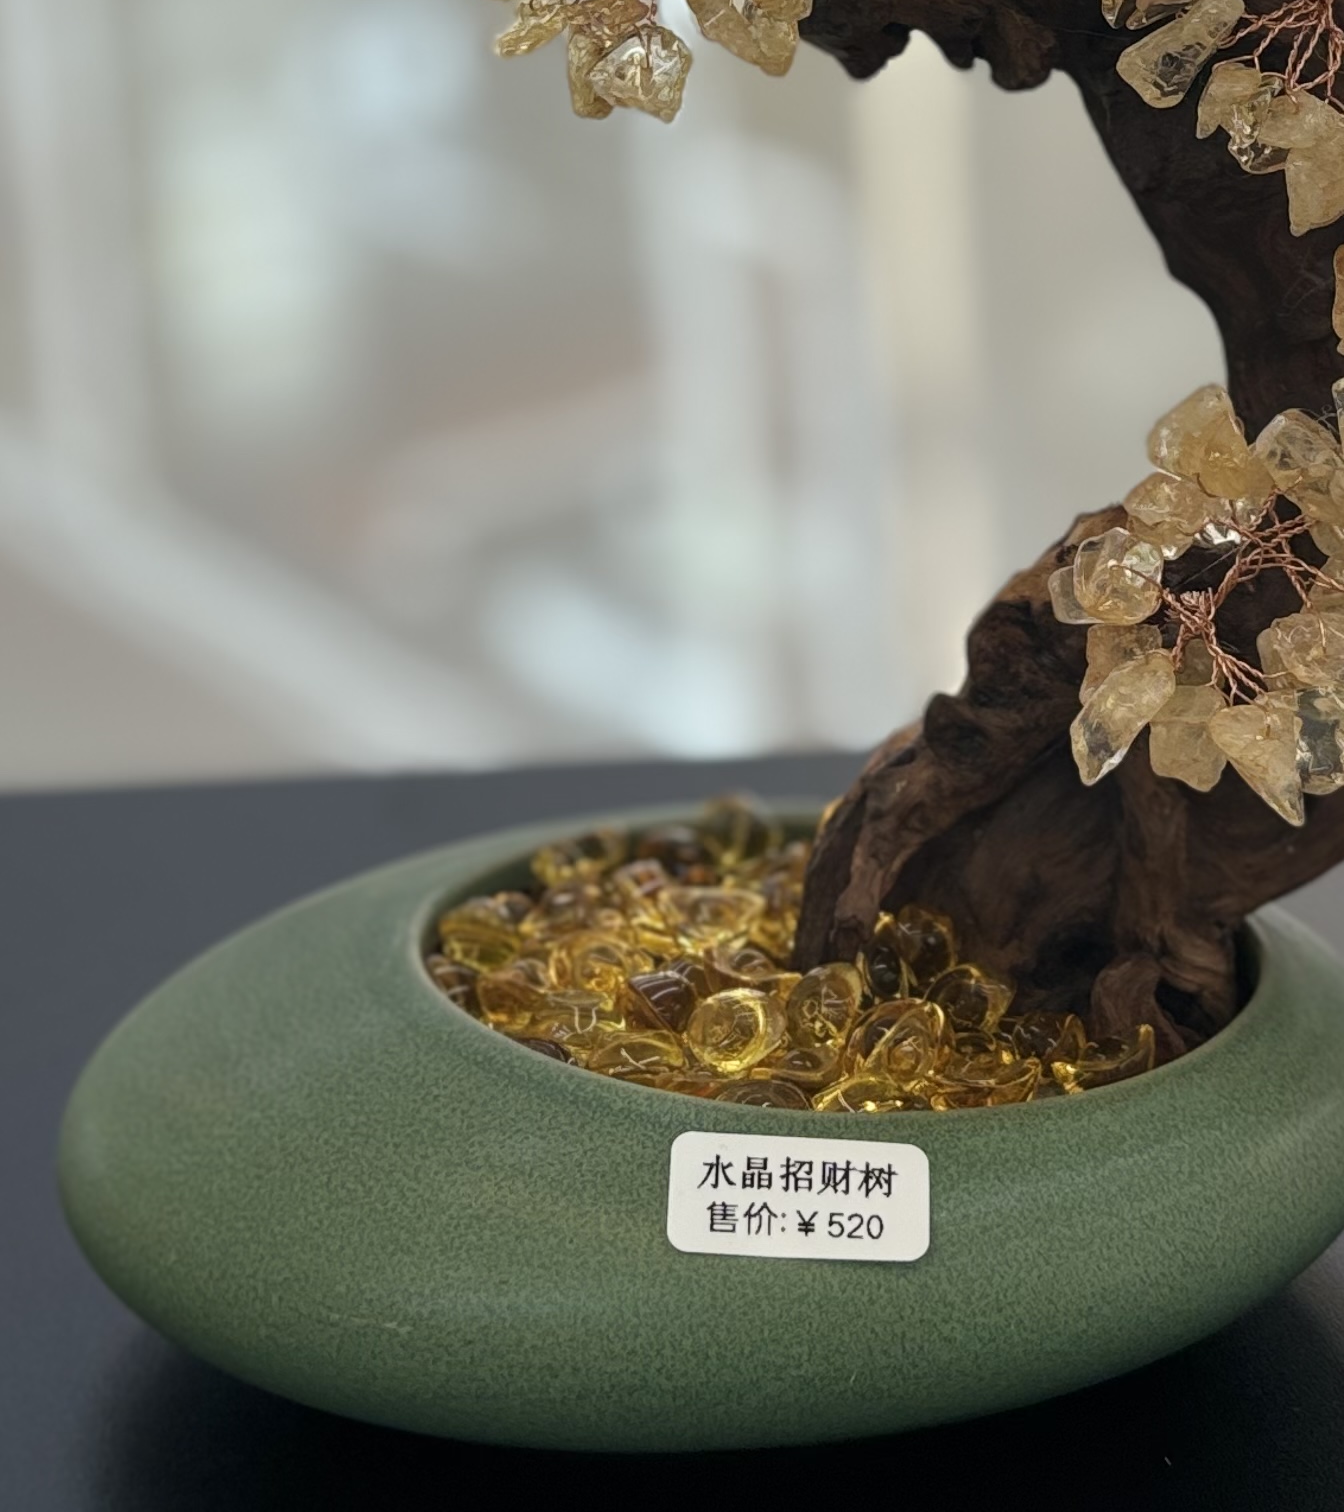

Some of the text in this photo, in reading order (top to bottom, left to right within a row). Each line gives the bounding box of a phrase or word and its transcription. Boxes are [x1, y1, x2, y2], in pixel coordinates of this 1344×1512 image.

[697, 1154, 899, 1198] 水晶招财树
